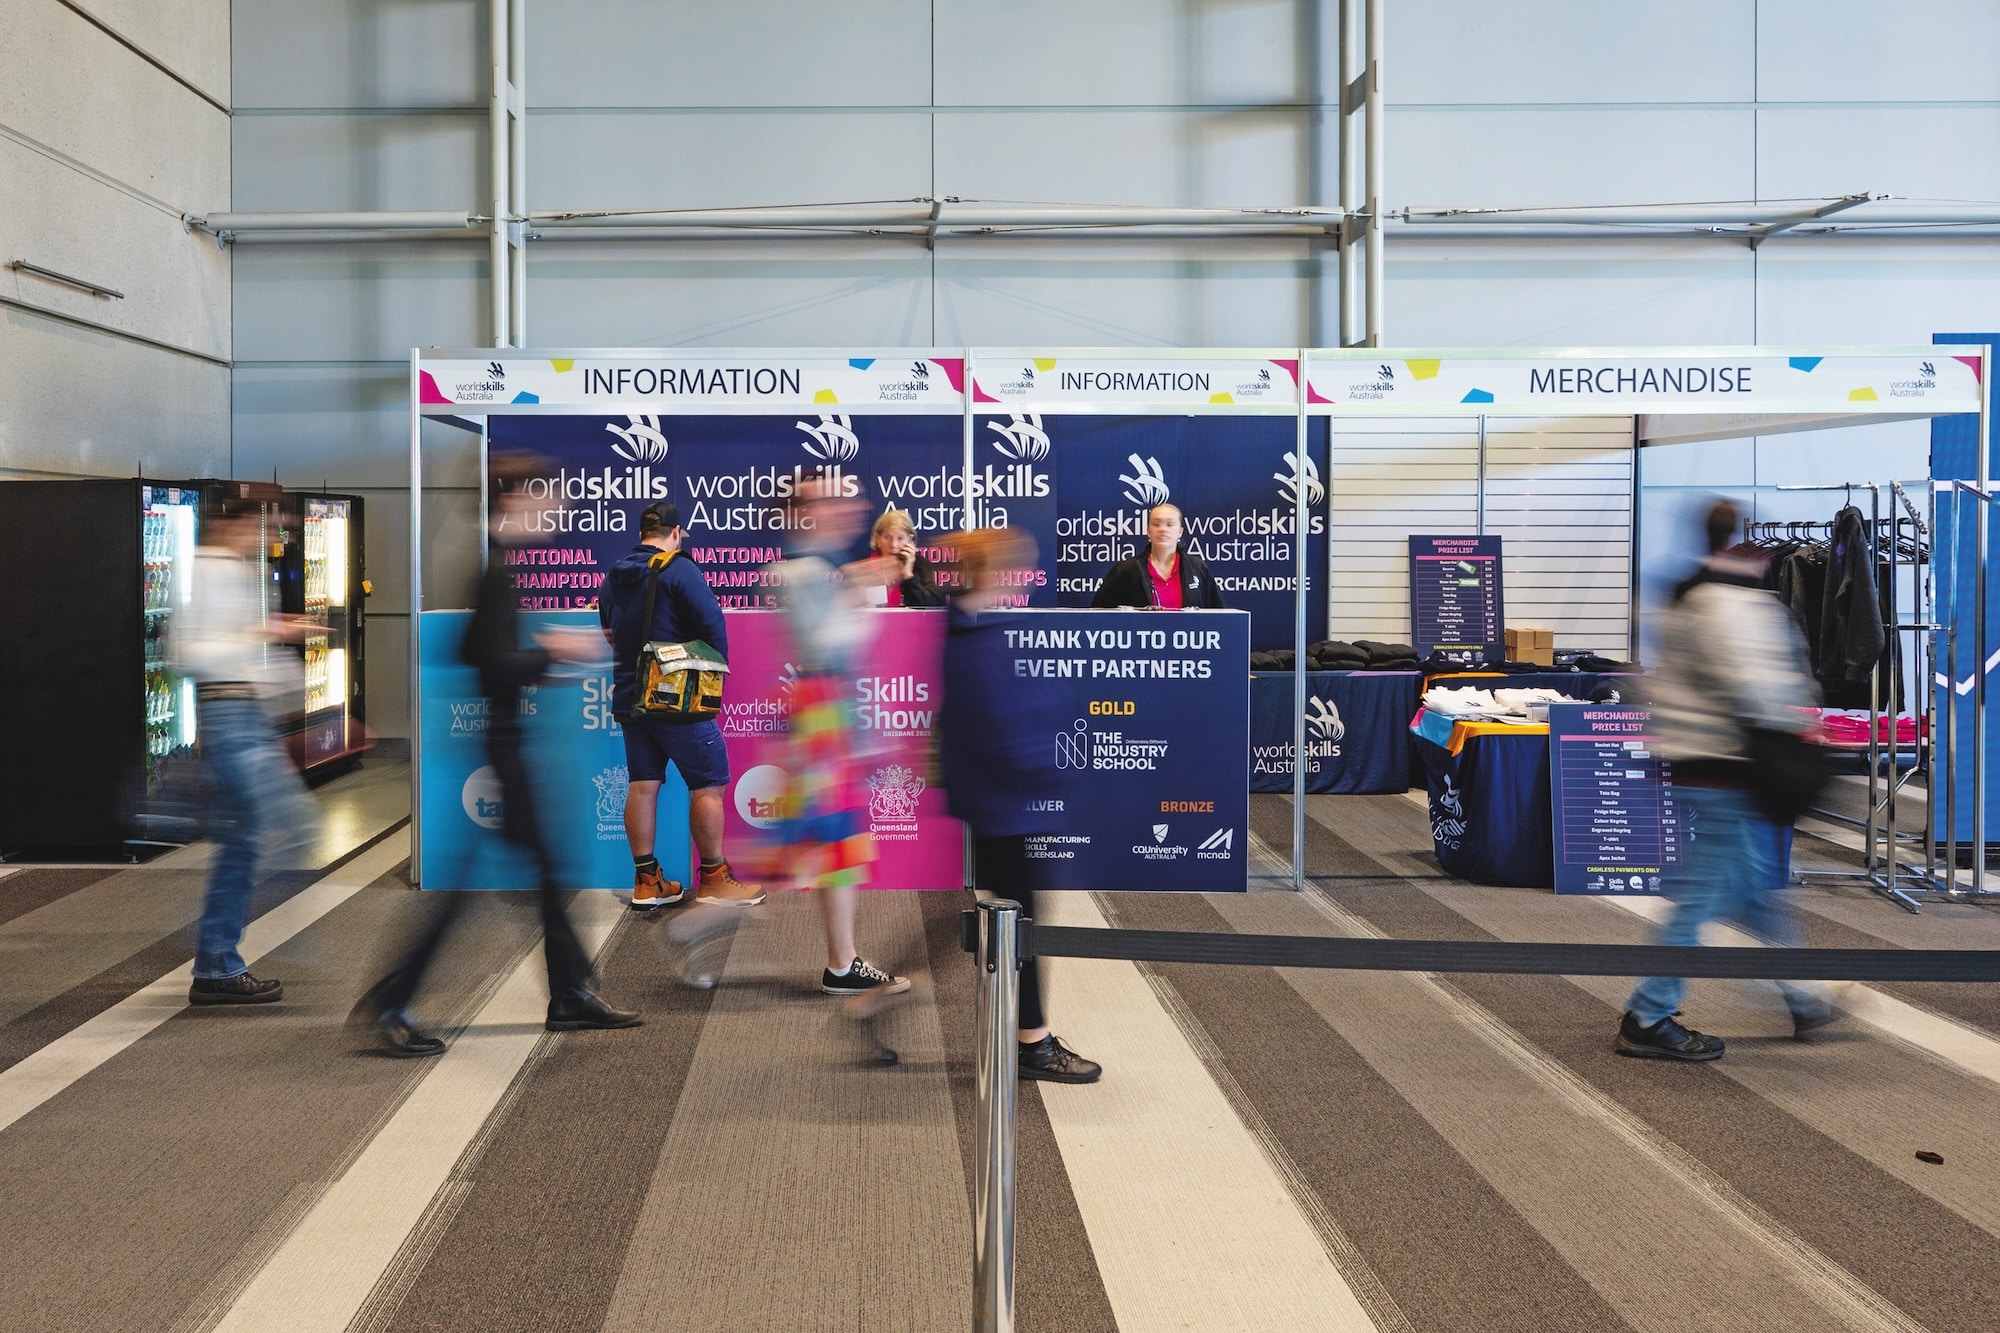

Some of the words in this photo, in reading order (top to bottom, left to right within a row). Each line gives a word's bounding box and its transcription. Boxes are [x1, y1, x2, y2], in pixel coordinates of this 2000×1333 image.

[455, 381, 505, 391] worldskills
[584, 368, 801, 394] INFORMATION
[879, 381, 929, 391] worldskills
[1061, 372, 1210, 391] INFORMATION
[1530, 367, 1752, 393] MERCHANDISE
[1890, 379, 1936, 389] worldskills
[1349, 382, 1394, 391] worldskills
[455, 391, 494, 401] Australia
[879, 391, 918, 401] Australia
[1349, 391, 1384, 400] Australia
[686, 498, 817, 531] Australia
[1057, 536, 1136, 562] ustralia
[1187, 535, 1290, 561] Australia
[504, 549, 597, 565] NATIONAL
[691, 547, 787, 564] NATIONAL
[1004, 630, 1081, 649] THANK
[1085, 630, 1132, 649] YOU
[1136, 631, 1166, 649] TO
[1173, 631, 1221, 650] OUR
[1014, 659, 1087, 678] EVENT
[1092, 660, 1212, 678] PARTNERS
[856, 675, 929, 702] Skills
[1089, 701, 1135, 716] GOLD
[856, 704, 932, 729] Show
[1583, 711, 1651, 720] MERCHANDISE
[722, 715, 790, 731] Australia
[1592, 723, 1621, 731] PRICE
[1622, 723, 1644, 731] LIST
[1093, 732, 1122, 744] THE
[1093, 745, 1168, 757] INDUSTRY
[1093, 758, 1156, 770] SCHOOL
[1253, 757, 1321, 773] Austrlia
[1161, 802, 1214, 813] BRONZE
[870, 823, 918, 832] Queensland
[870, 833, 918, 841] Government
[1132, 845, 1188, 856] CQUniversity
[1197, 849, 1231, 859] mcnab
